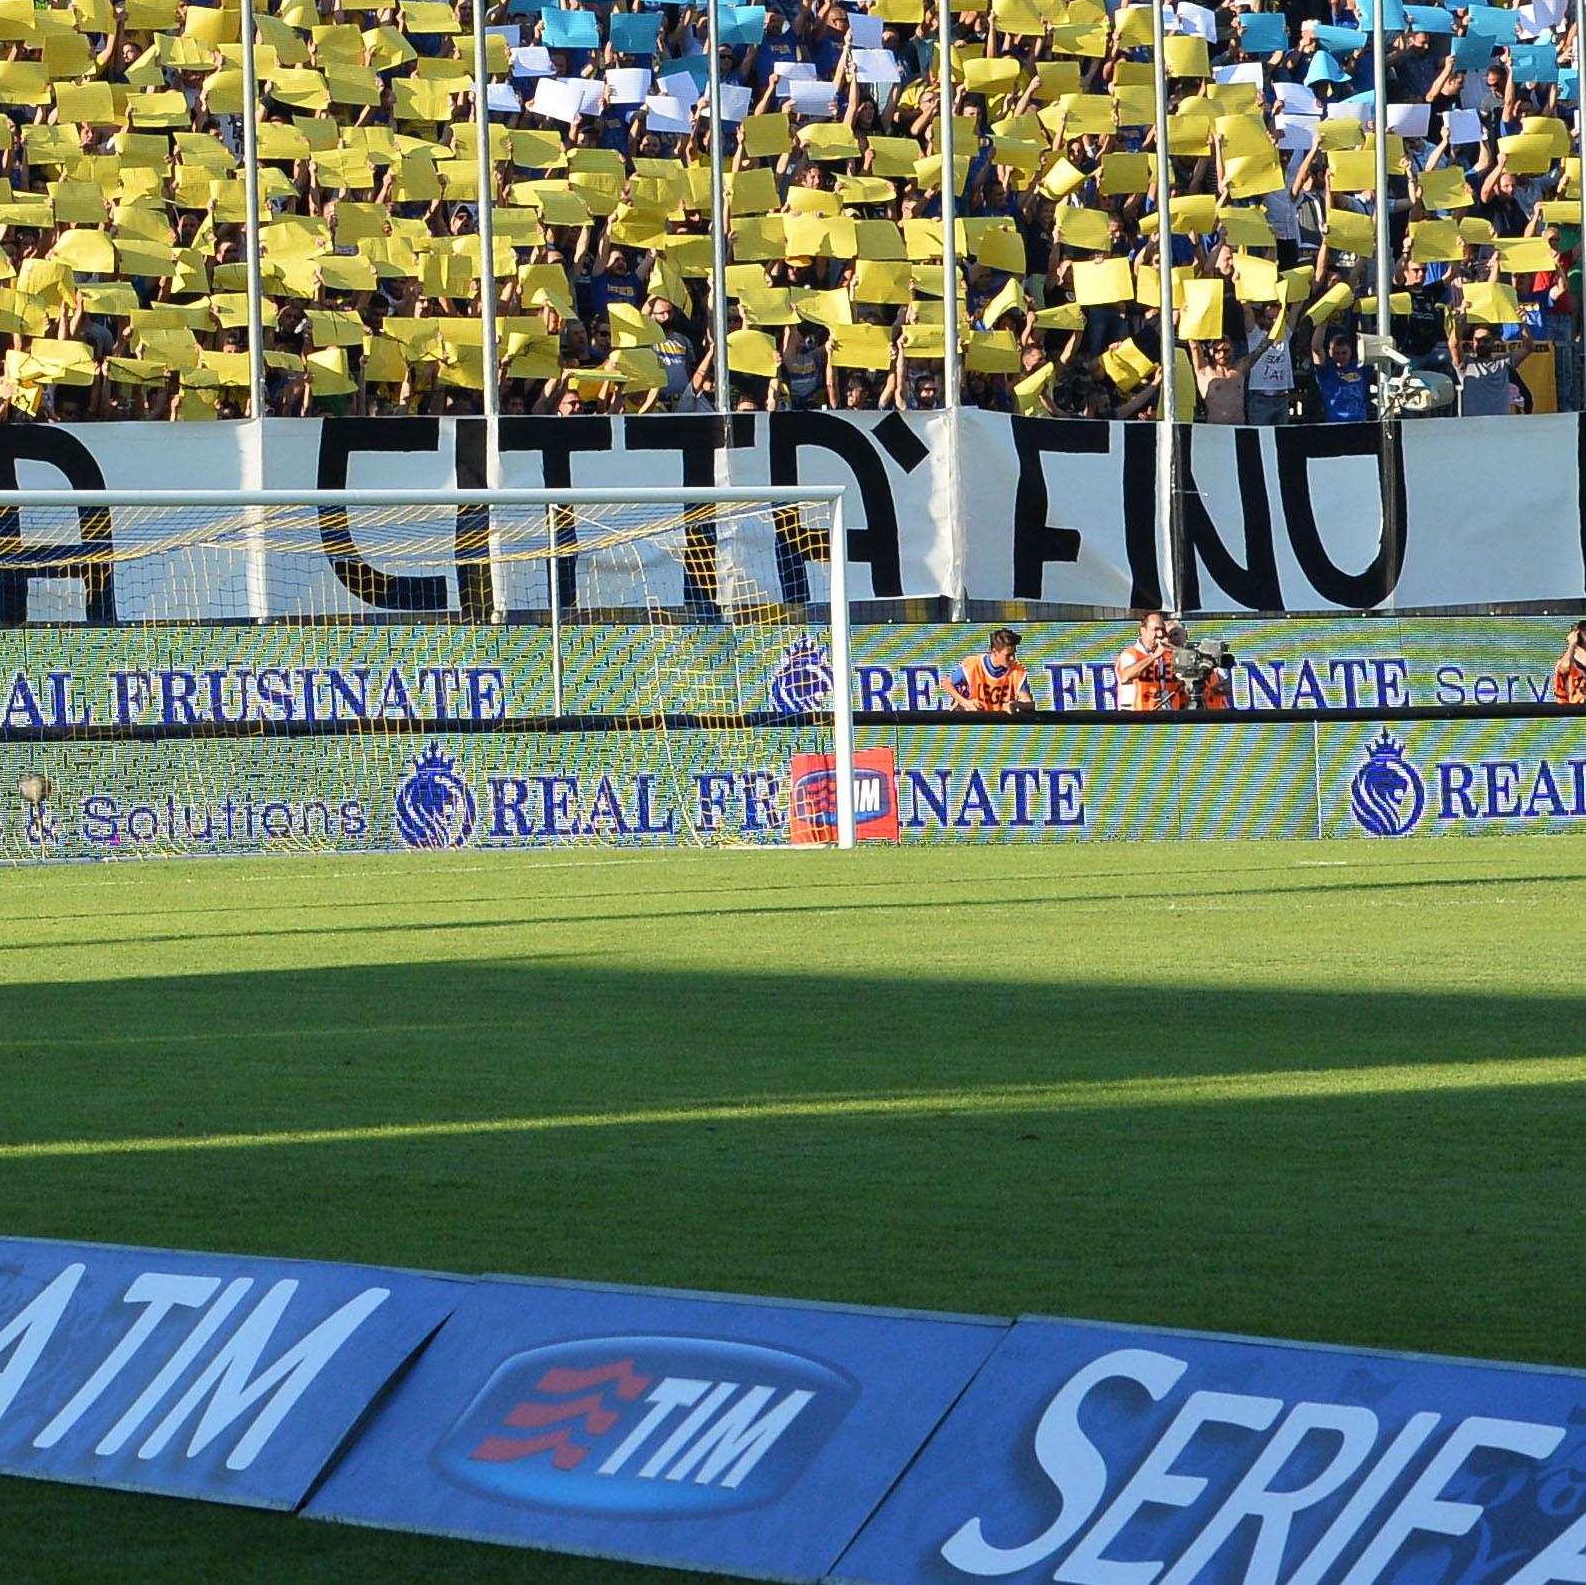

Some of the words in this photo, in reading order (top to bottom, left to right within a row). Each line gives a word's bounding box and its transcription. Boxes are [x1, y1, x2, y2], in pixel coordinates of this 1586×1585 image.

[1012, 415, 1408, 611] FINO
[109, 666, 507, 724] FRUSINATE
[1044, 658, 1410, 711] FRNATE
[83, 796, 368, 842] Solutions
[489, 772, 677, 837] REAL
[694, 767, 1086, 831] FRNATE
[33, 1272, 391, 1470] TIM
[596, 1376, 817, 1489] TIM
